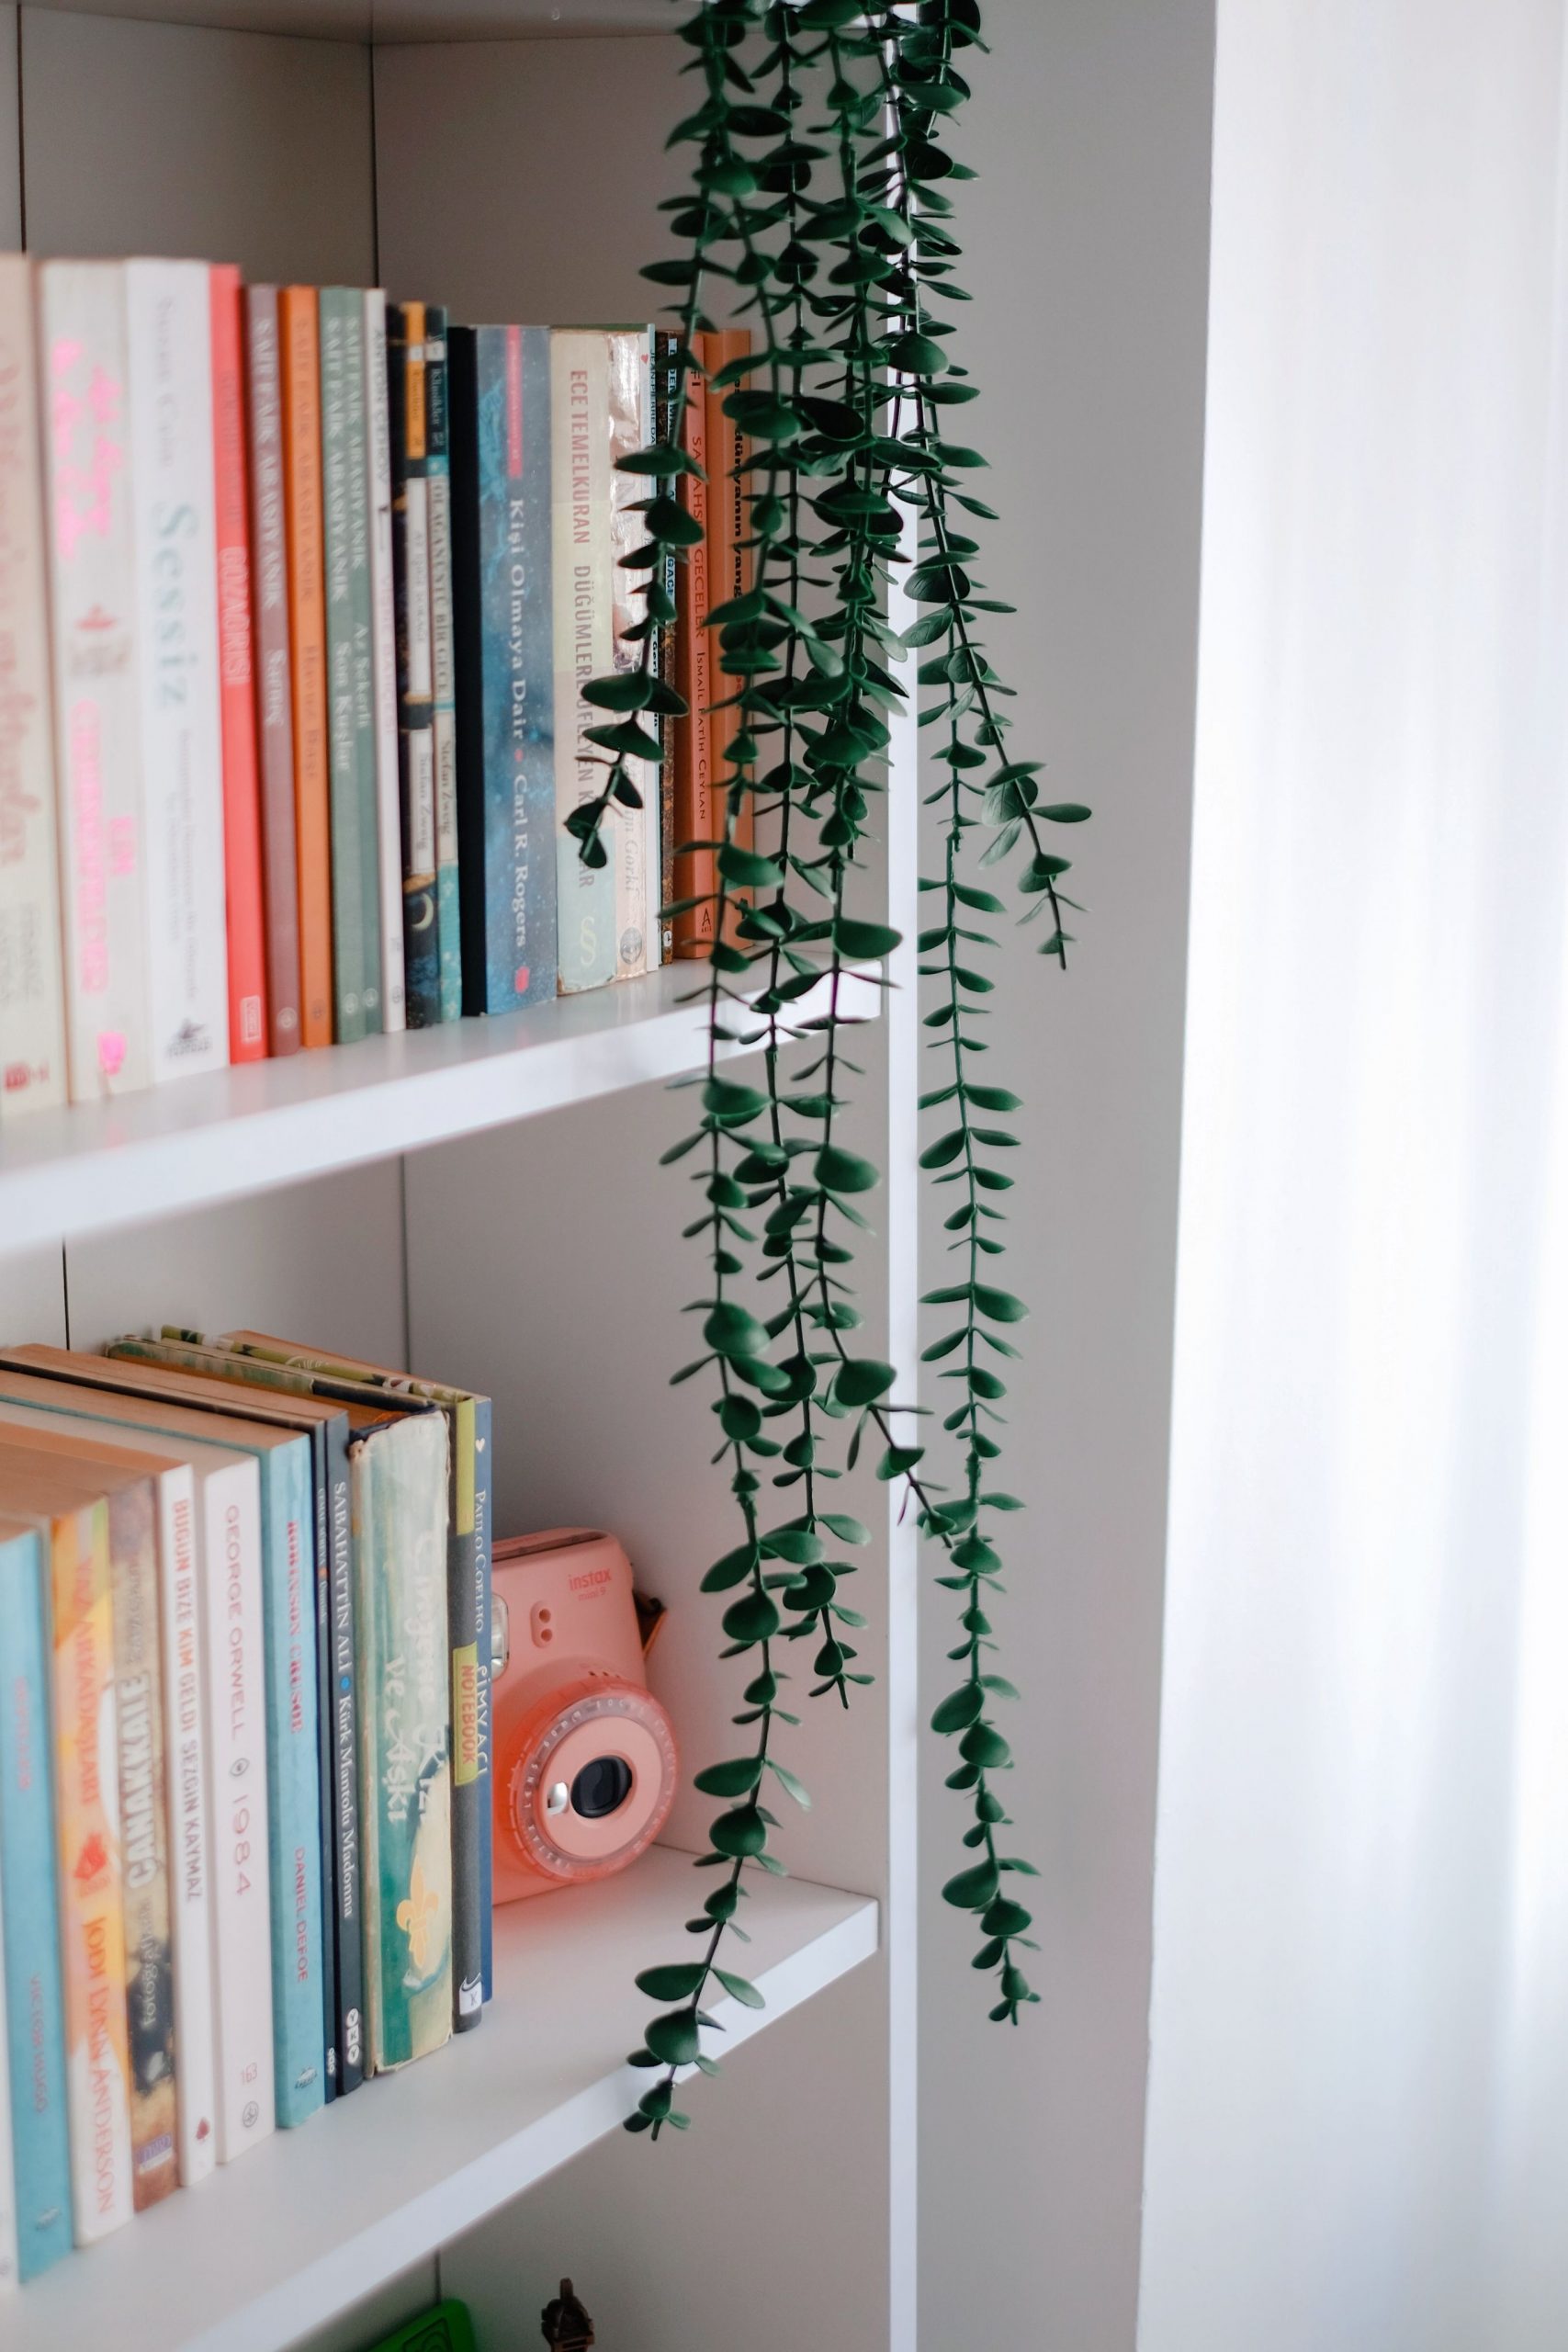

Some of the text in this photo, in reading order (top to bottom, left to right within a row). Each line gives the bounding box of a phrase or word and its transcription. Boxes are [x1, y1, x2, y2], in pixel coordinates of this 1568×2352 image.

[570, 370, 589, 405] ECE
[571, 410, 591, 545] TEMELKURAN
[508, 498, 525, 554] Kişi
[509, 563, 526, 669] Olmaya
[694, 548, 705, 639] GECELER
[512, 677, 527, 740] Dair
[513, 774, 529, 826] Carl
[698, 759, 708, 820] CEYLAN
[512, 864, 530, 947] Rogers
[474, 1554, 487, 1633] COELHO
[569, 1568, 612, 1591] instax
[226, 1504, 252, 1895] GEORGE ORWELL 1984
[333, 1480, 356, 1919] SABAHATTİN ALİ Kürk Mantolu Madonna
[385, 1655, 408, 1699] ve
[461, 1664, 477, 1765] NOTEBOOK
[294, 1847, 308, 1918] DANIEL
[297, 1922, 310, 1983] DEFOE
[92, 2066, 116, 2217] ANDERSON
